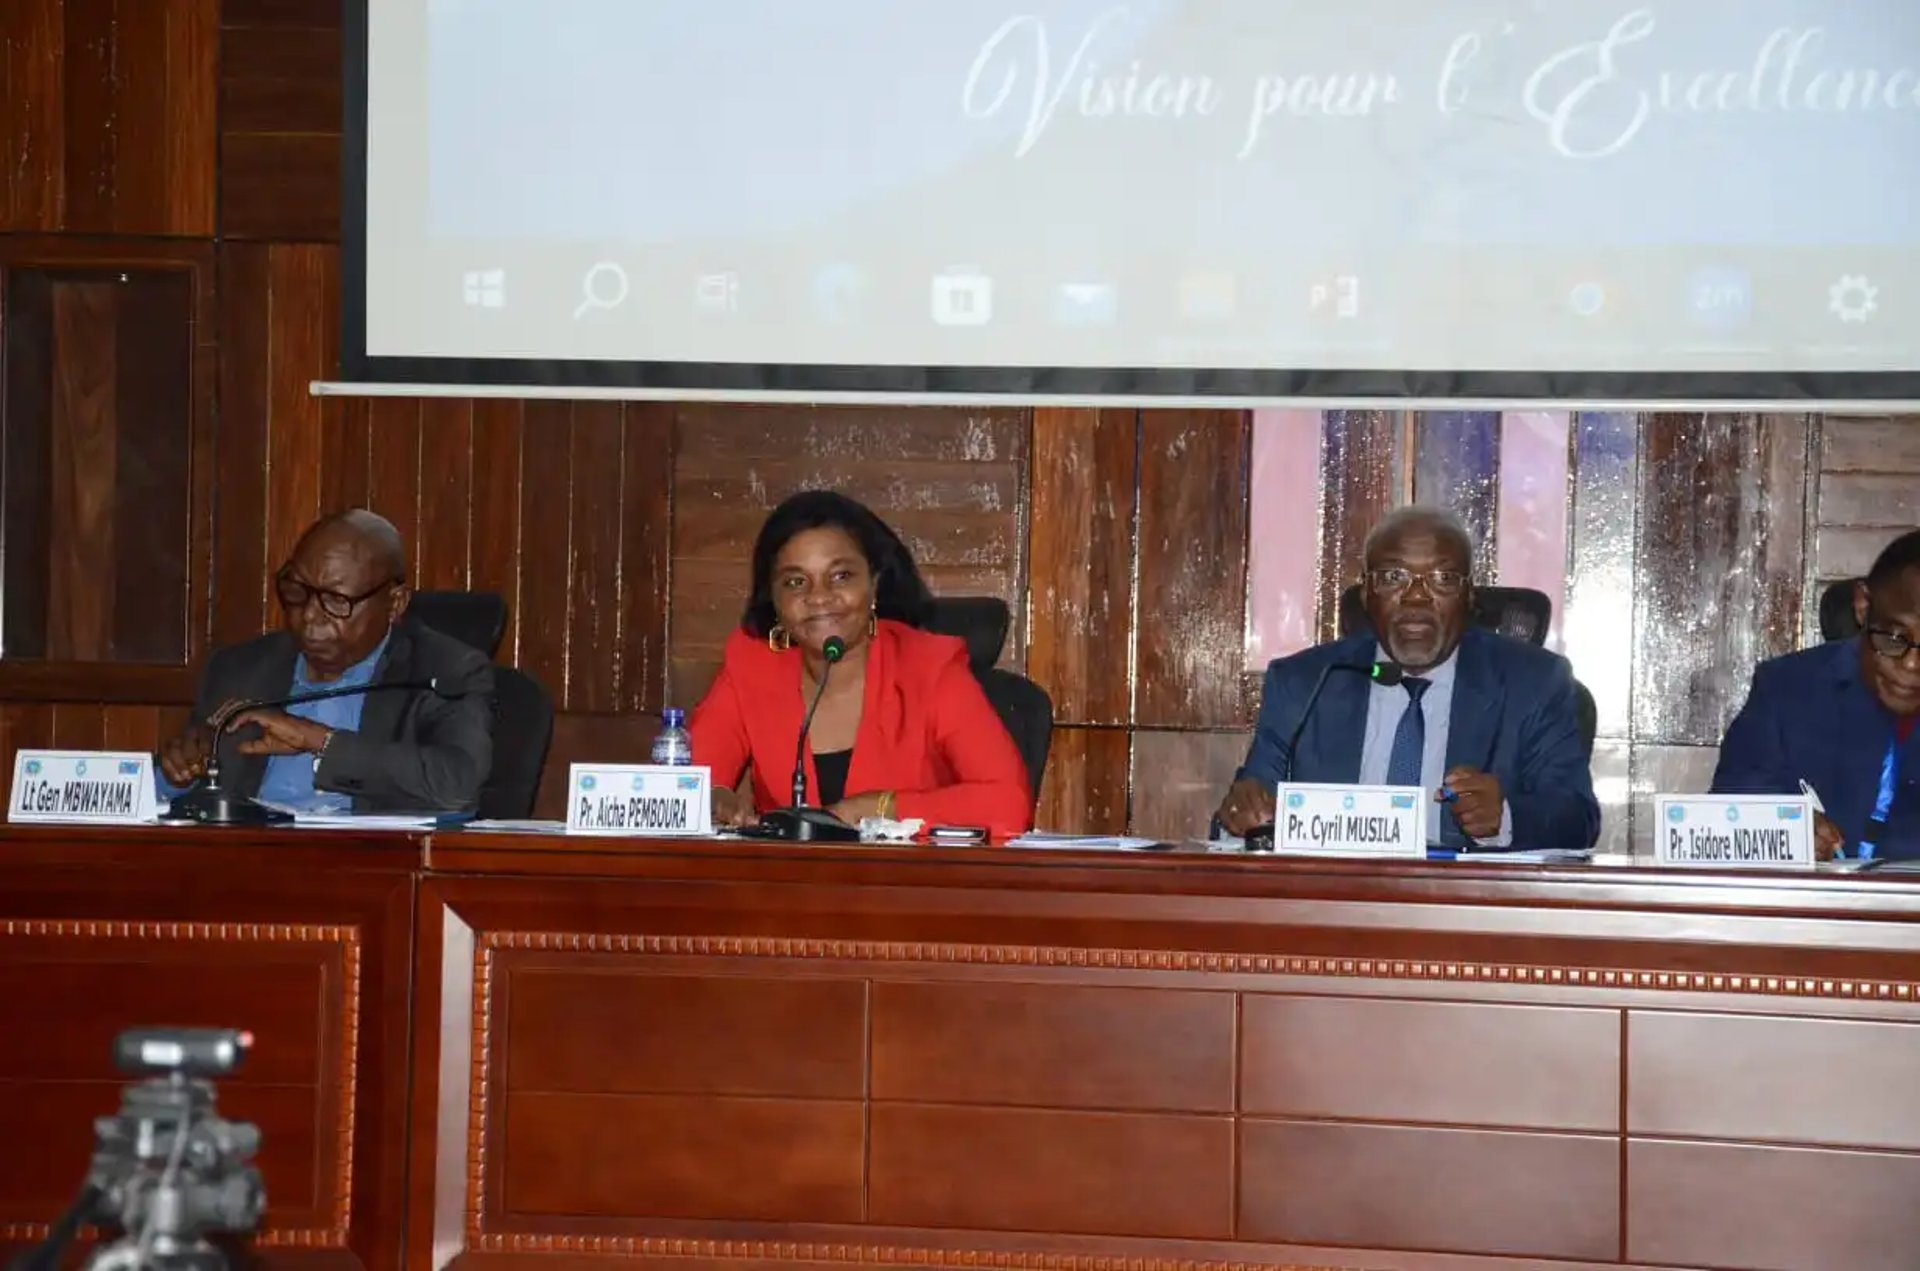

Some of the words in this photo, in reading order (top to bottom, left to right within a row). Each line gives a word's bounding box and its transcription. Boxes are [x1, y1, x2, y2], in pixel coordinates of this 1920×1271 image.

[962, 6, 1220, 159] Vision
[1236, 70, 1402, 161] pour
[21, 780, 36, 811] Lt
[37, 780, 60, 812] Gen
[61, 781, 133, 814] MBWAYAMA
[579, 797, 594, 827] Pr.
[627, 797, 687, 828] PEMBOURA
[1288, 814, 1307, 841] Pr.
[1311, 814, 1343, 847] Cyril
[1346, 815, 1401, 843] MUSILA
[1669, 827, 1687, 860] Pr.
[1689, 826, 1731, 860] Isidore
[1733, 828, 1794, 861] NDAYWEL
